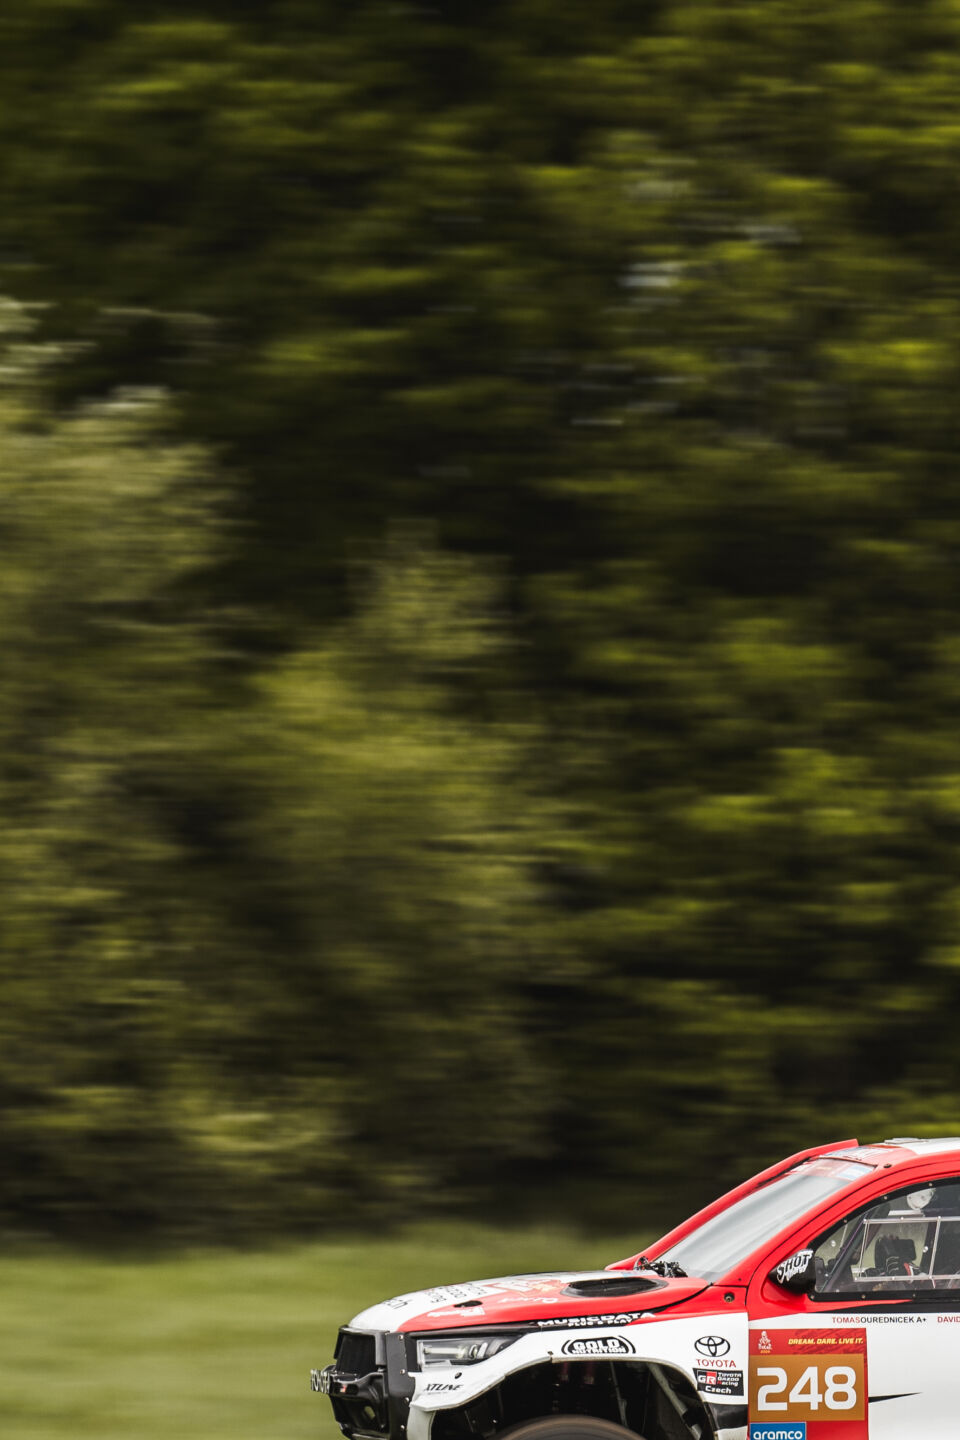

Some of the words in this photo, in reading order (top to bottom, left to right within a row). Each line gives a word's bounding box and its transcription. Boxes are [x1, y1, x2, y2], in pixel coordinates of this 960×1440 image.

[776, 1252, 811, 1283] SHOT
[537, 1313, 656, 1326] MUSICDATA
[832, 1316, 914, 1324] TOMASOUREDNICEK
[573, 1339, 620, 1350] GOLD
[696, 1359, 736, 1368] TOYOTA
[698, 1375, 716, 1385] GR
[705, 1385, 732, 1394] Czech
[757, 1366, 857, 1411] 248
[753, 1431, 803, 1440] aramco
